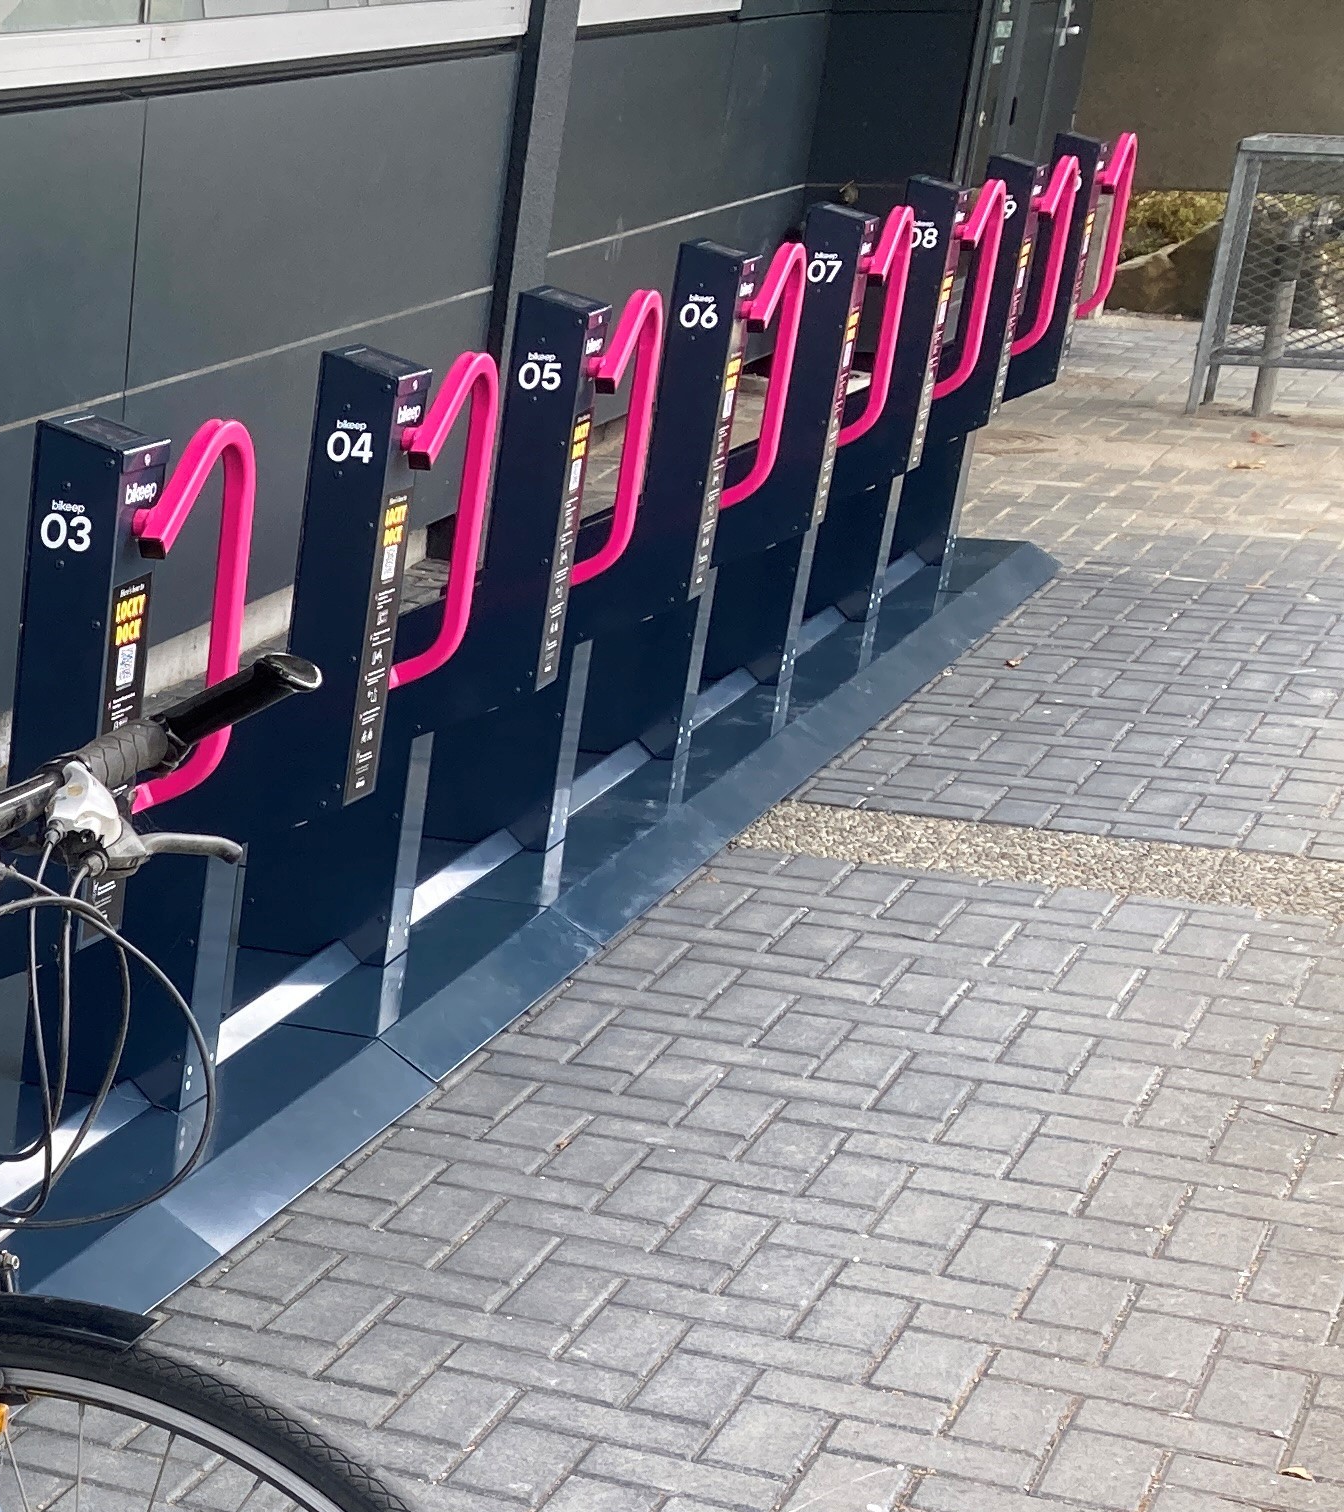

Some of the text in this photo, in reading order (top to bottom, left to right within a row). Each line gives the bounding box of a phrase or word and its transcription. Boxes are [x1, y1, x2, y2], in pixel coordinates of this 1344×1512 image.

[807, 260, 842, 283] 07
[680, 303, 718, 329] 06
[518, 362, 562, 391] 05
[326, 430, 374, 464] 04
[51, 499, 86, 514] bikeep
[125, 482, 158, 505] bikeep
[40, 512, 92, 552] 03
[116, 593, 147, 623] LOCKY
[115, 618, 142, 647] DOCK
